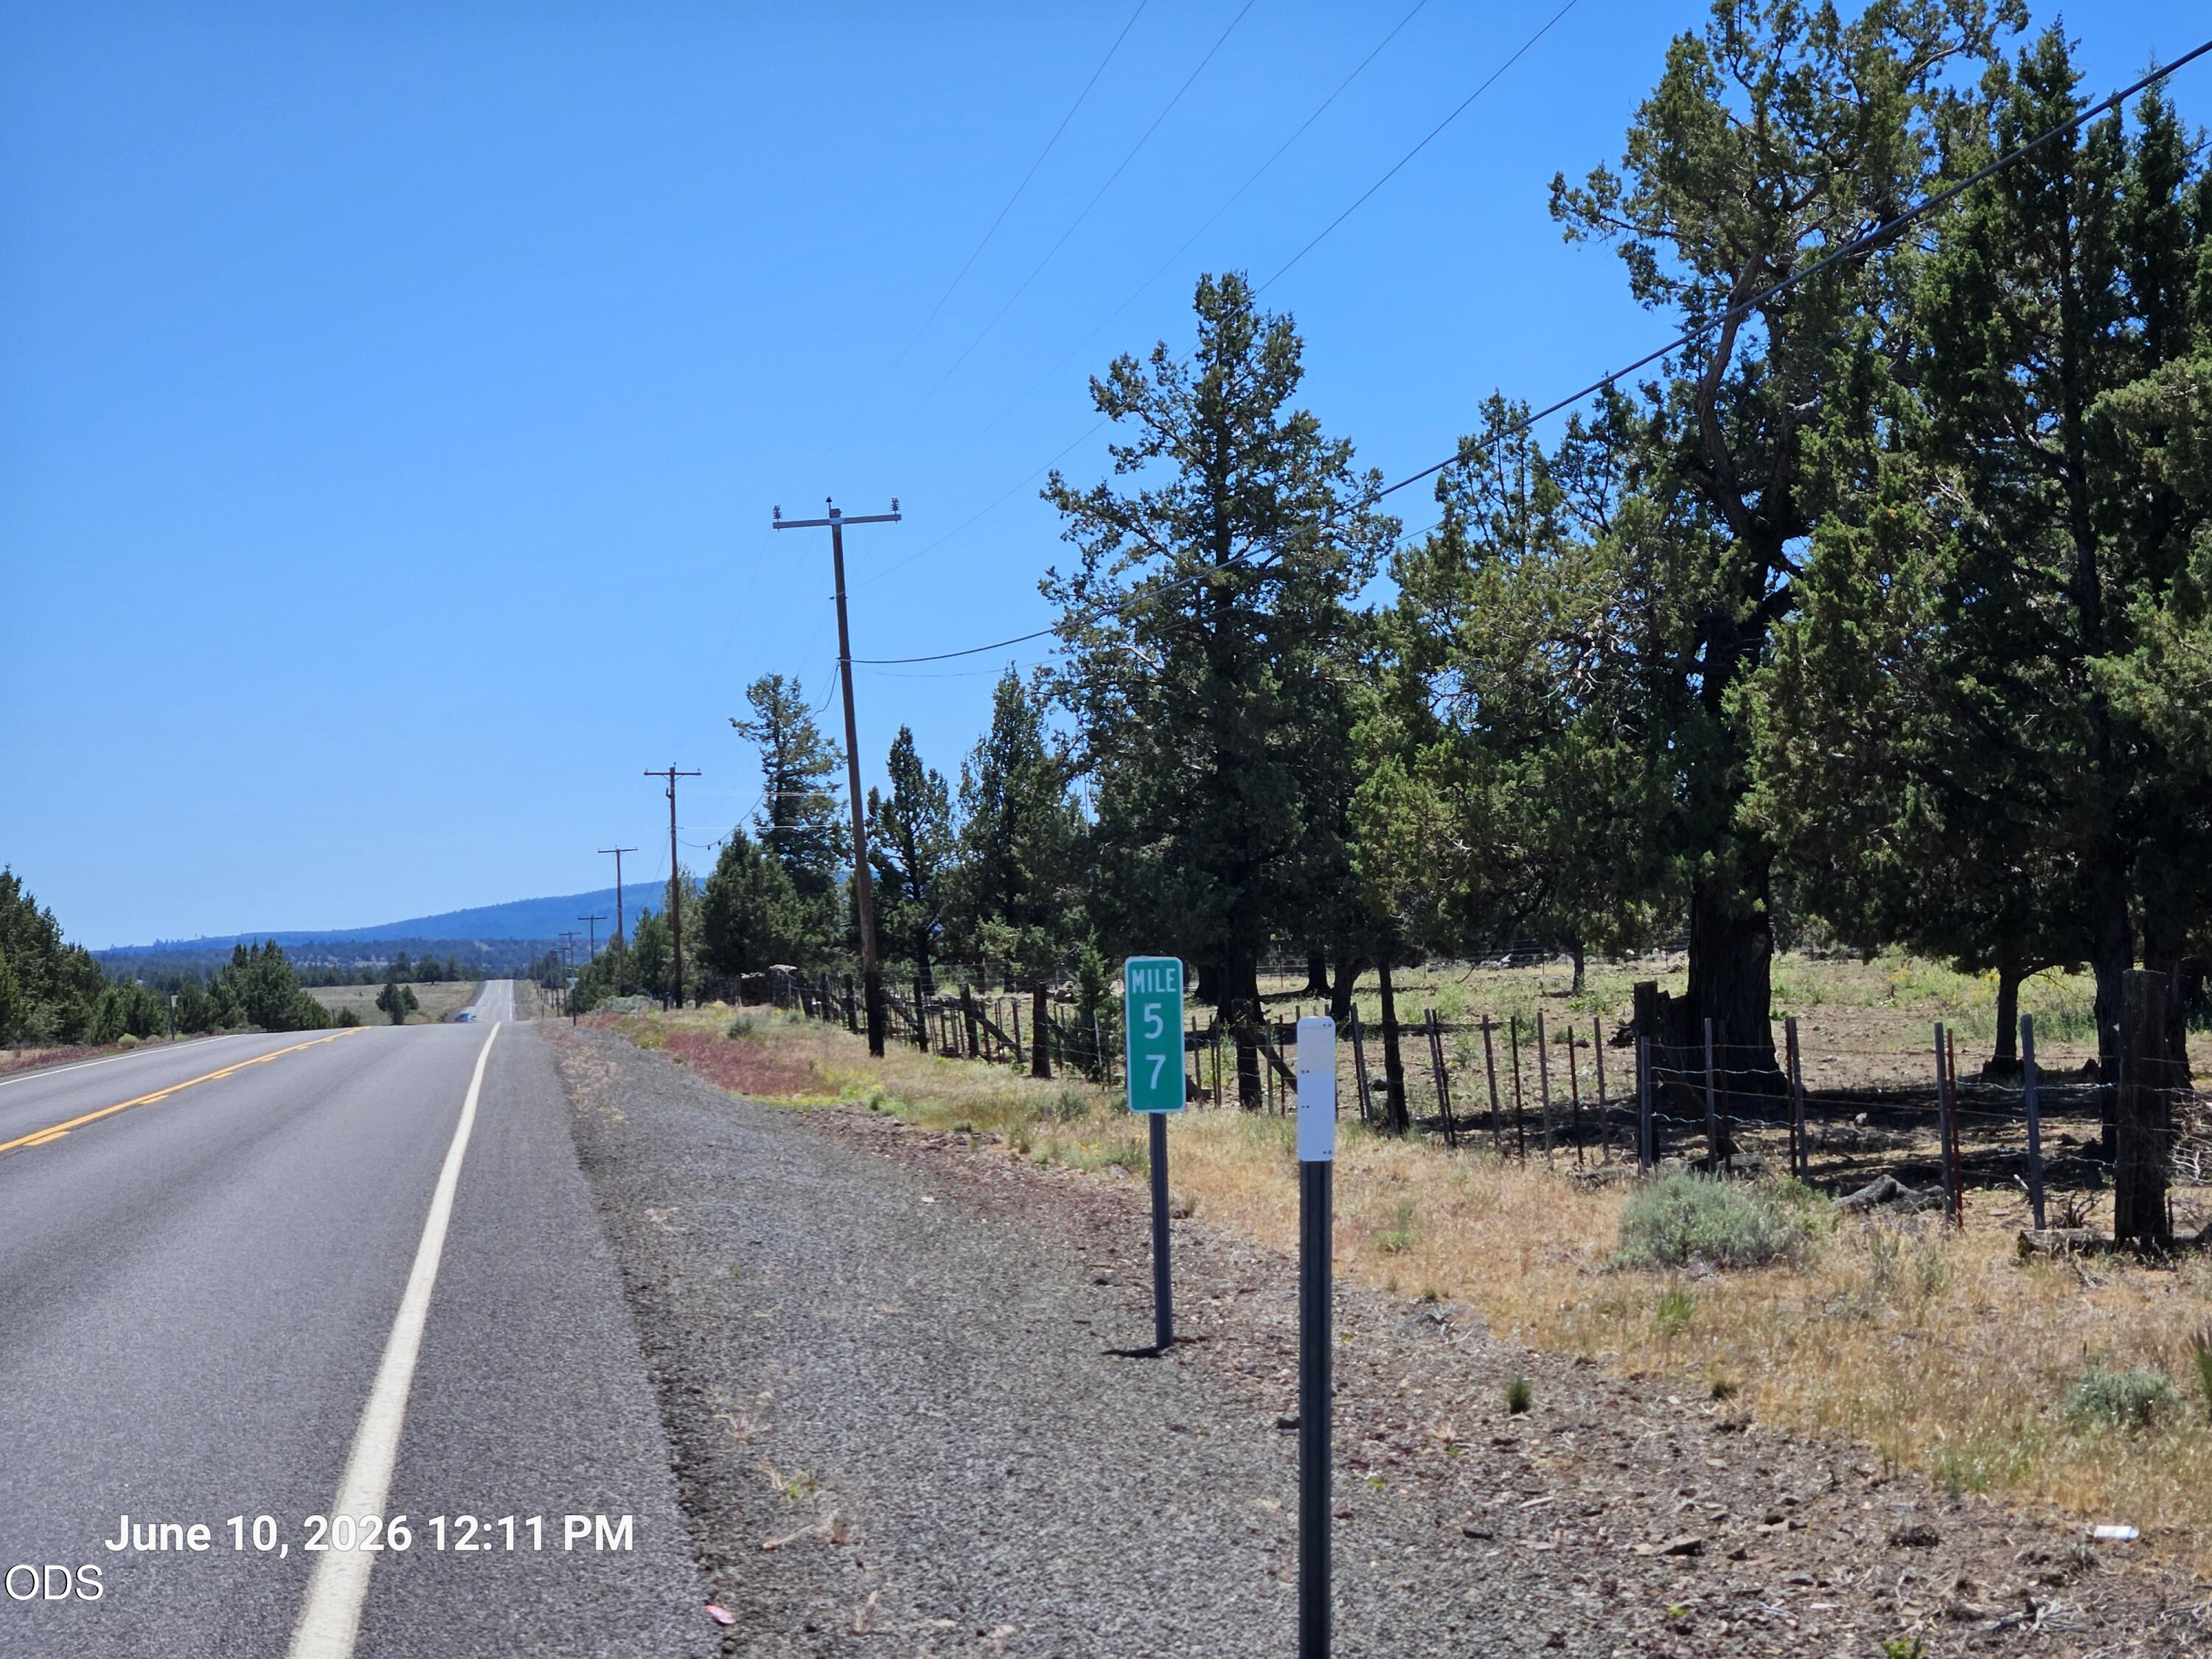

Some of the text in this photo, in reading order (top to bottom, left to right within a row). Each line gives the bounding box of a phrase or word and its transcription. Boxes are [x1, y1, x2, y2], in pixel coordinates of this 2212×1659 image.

[1132, 967, 1177, 993] MILE
[1144, 1002, 1164, 1039] 5
[1146, 1054, 1166, 1090] 7
